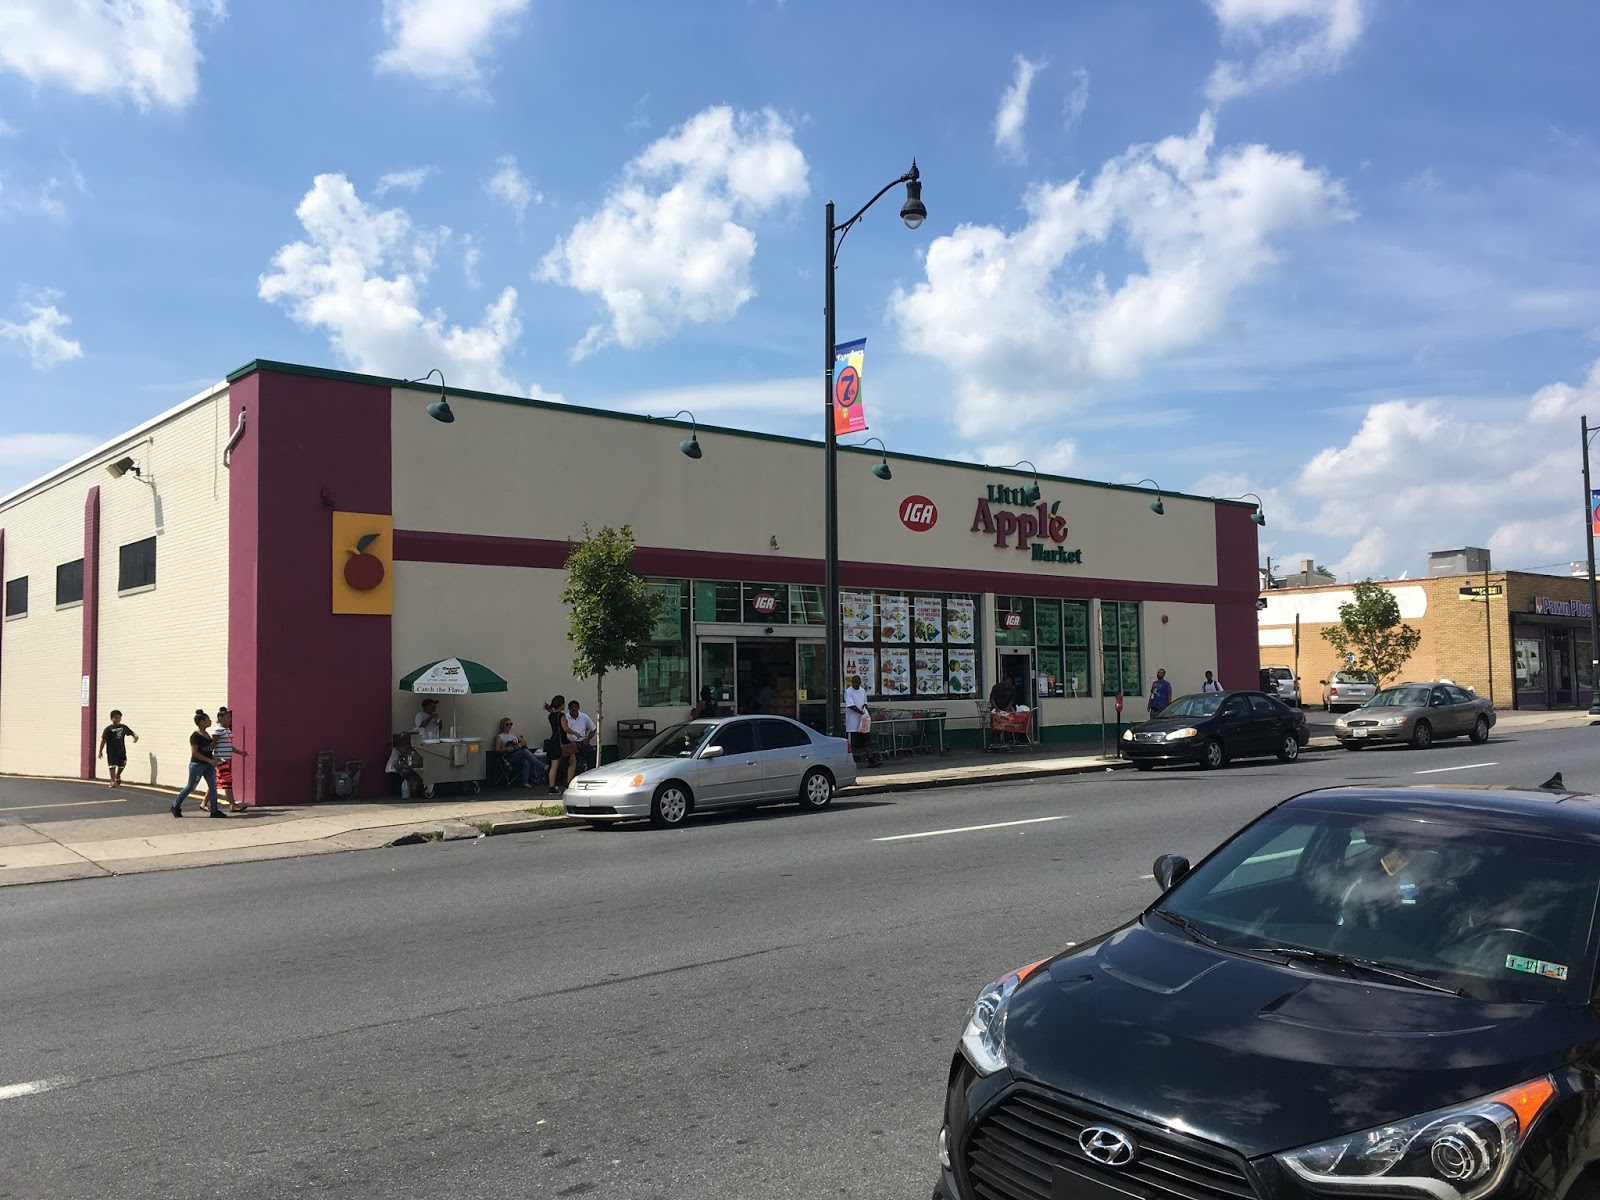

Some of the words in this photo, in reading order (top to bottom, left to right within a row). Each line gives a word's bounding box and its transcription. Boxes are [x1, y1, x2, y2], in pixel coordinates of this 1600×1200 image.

[903, 502, 934, 524] IGA
[971, 497, 1068, 550] Apple
[1031, 543, 1082, 564] Market
[754, 596, 775, 610] IGA
[1543, 596, 1570, 616] Pawn
[1570, 599, 1591, 618] Plus
[1006, 615, 1020, 626] IGA
